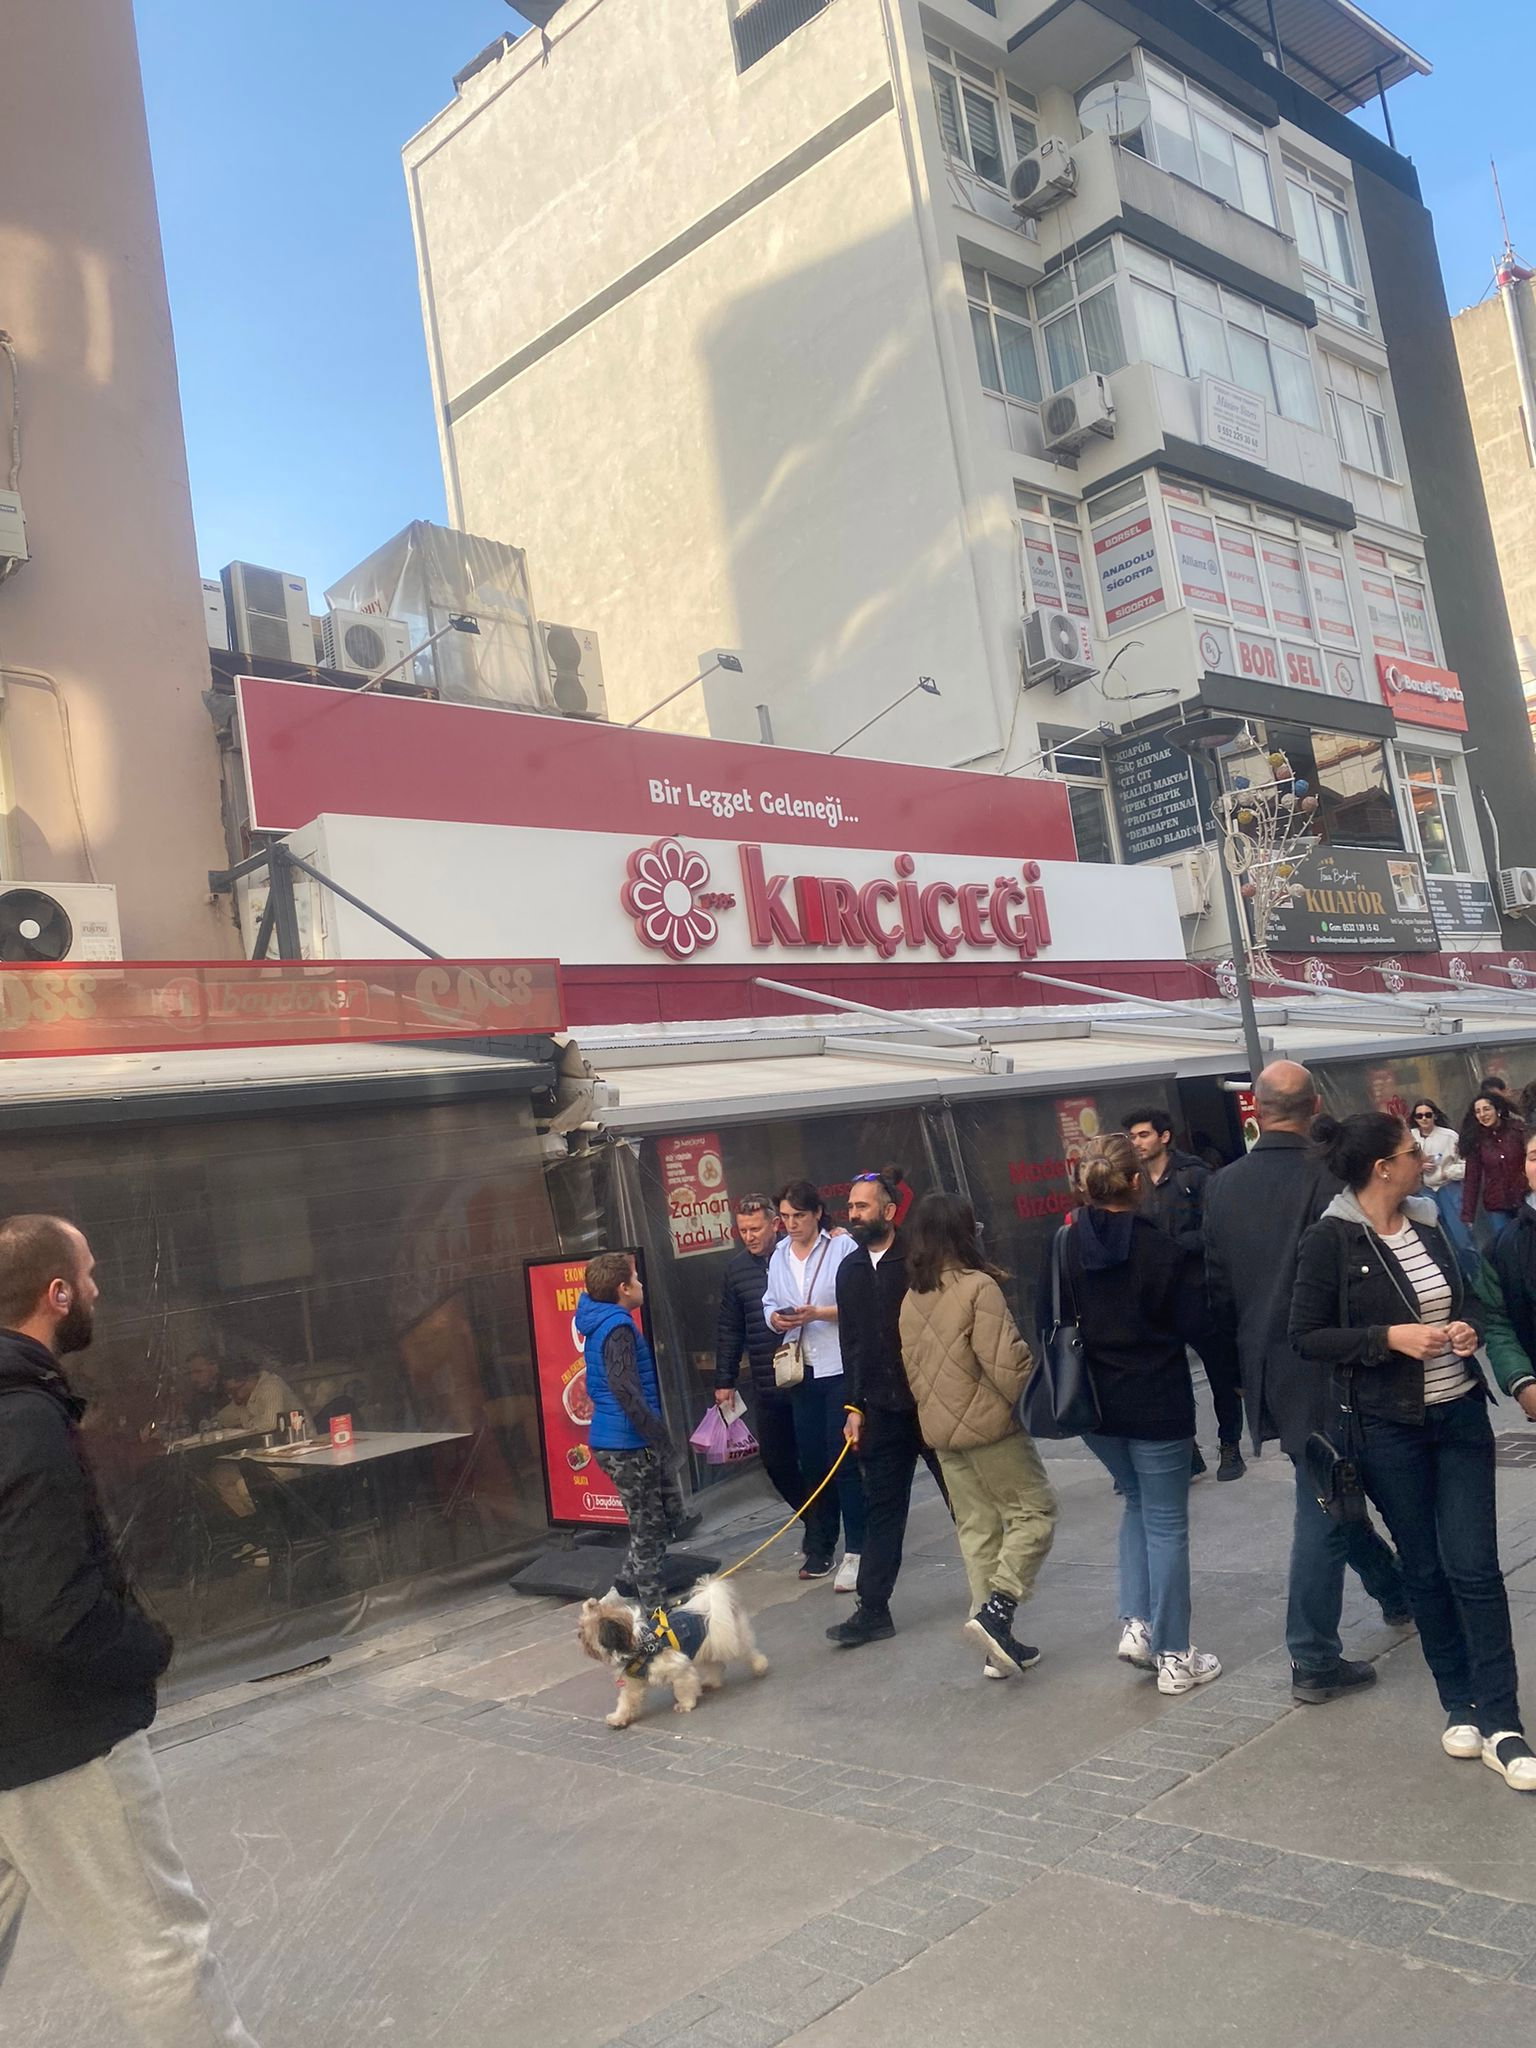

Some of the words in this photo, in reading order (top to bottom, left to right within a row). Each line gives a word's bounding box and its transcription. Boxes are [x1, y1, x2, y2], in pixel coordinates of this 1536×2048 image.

[1104, 525, 1142, 548] BORSEL
[1102, 549, 1155, 580] ANADOLU
[1181, 553, 1208, 571] Allianz
[1106, 565, 1154, 592] SİGORTA
[1115, 595, 1156, 618] SİGORTA
[1402, 610, 1424, 632] HDI
[1239, 641, 1277, 679] BOR
[1286, 652, 1321, 688] SEL
[1405, 674, 1432, 695] Borsel
[1431, 681, 1465, 704] Sigorta
[1136, 748, 1172, 768] KAYNAK
[1122, 784, 1152, 801] KALICI
[1153, 770, 1189, 790] MAKYAJ
[648, 778, 682, 805] Bir
[686, 783, 754, 819] Lezzet
[759, 791, 860, 828] Geleneği...
[1127, 808, 1163, 827] PROTEZ
[1129, 817, 1179, 840] DERMAPEN
[737, 843, 1053, 960] KIRÇİÇEĞİ
[1304, 884, 1387, 915] KUAFÖR
[670, 1198, 730, 1220] Zaman
[674, 1225, 713, 1248] tadı
[563, 1266, 587, 1282] EKON
[555, 1287, 588, 1312] MEN
